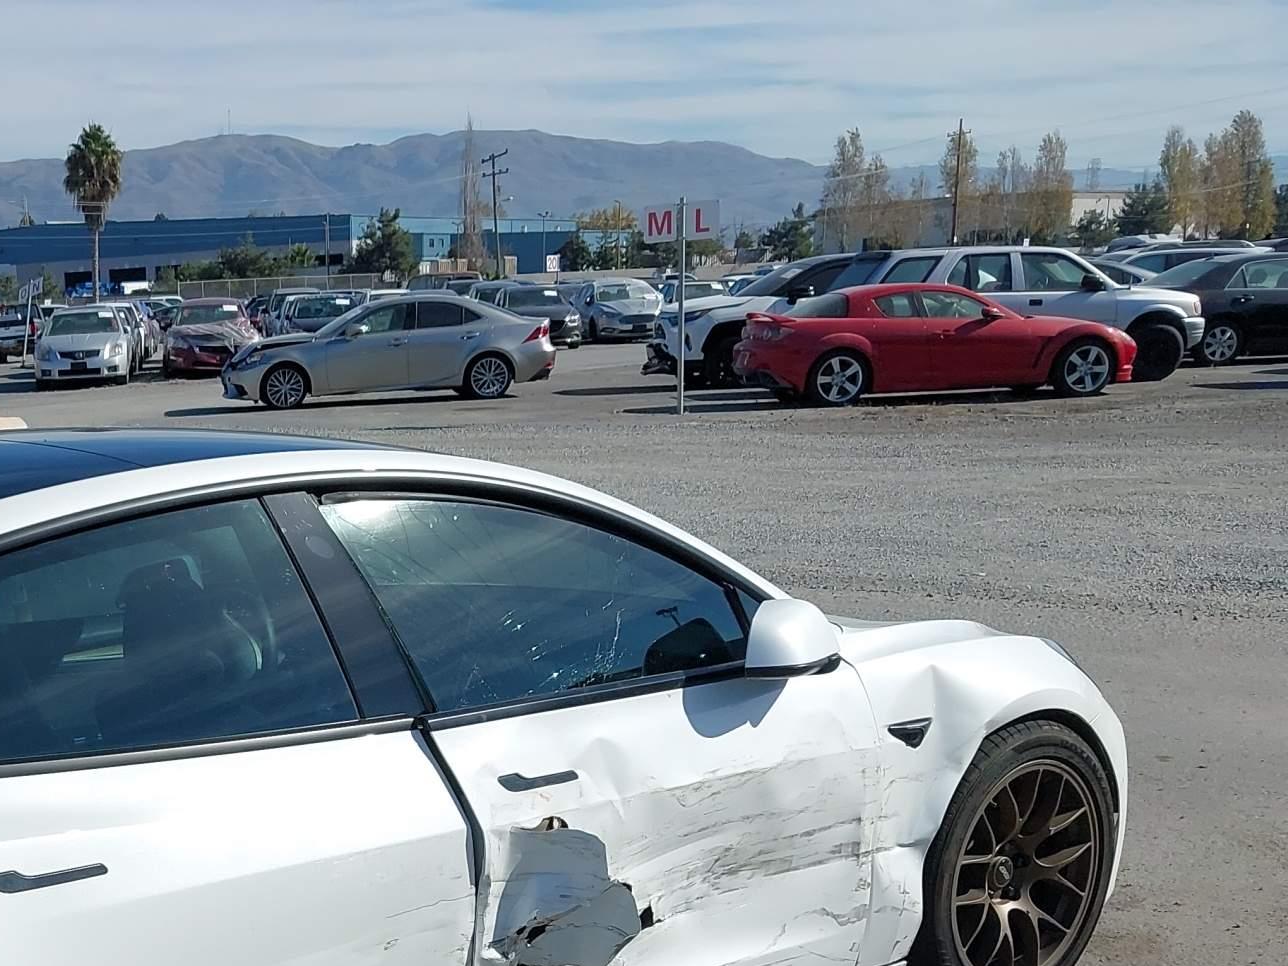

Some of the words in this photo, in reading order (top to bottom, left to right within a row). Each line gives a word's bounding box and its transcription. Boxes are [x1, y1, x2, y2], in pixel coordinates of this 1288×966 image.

[648, 211, 672, 236] M
[696, 208, 710, 233] L
[547, 256, 557, 270] 20
